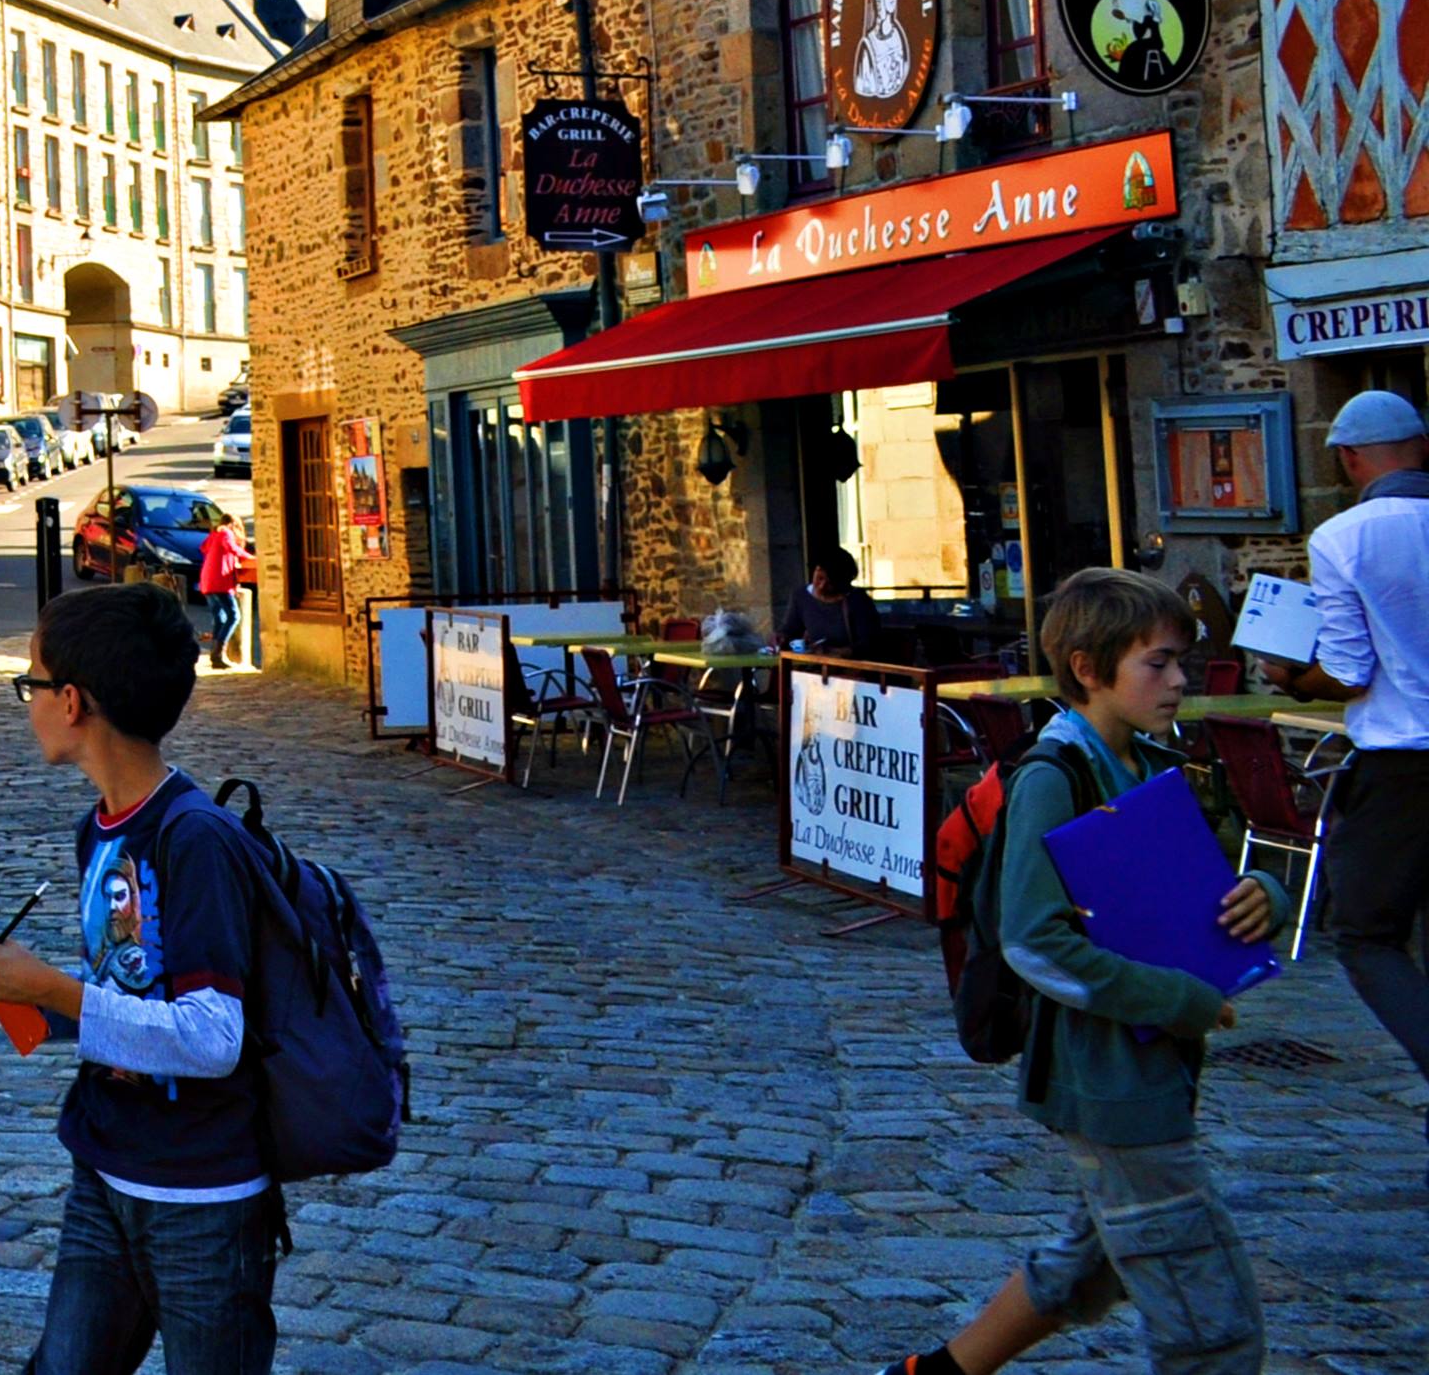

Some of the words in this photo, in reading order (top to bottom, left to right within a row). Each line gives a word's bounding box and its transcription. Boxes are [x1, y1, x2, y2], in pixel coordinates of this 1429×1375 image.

[557, 129, 606, 141] GRILL
[568, 148, 599, 168] La
[535, 172, 637, 199] Duchesse
[553, 203, 622, 224] Anne
[748, 230, 782, 275] La
[796, 205, 950, 266] Duchesse
[973, 179, 1079, 234] Anne
[457, 632, 481, 654] BAR
[458, 694, 494, 724] GRILL
[835, 690, 879, 728] BAR
[833, 737, 920, 786] CREPERIE
[833, 784, 900, 831] GRILL
[794, 818, 812, 847] La
[814, 822, 876, 867] Duchesse
[880, 845, 922, 880] Anne
